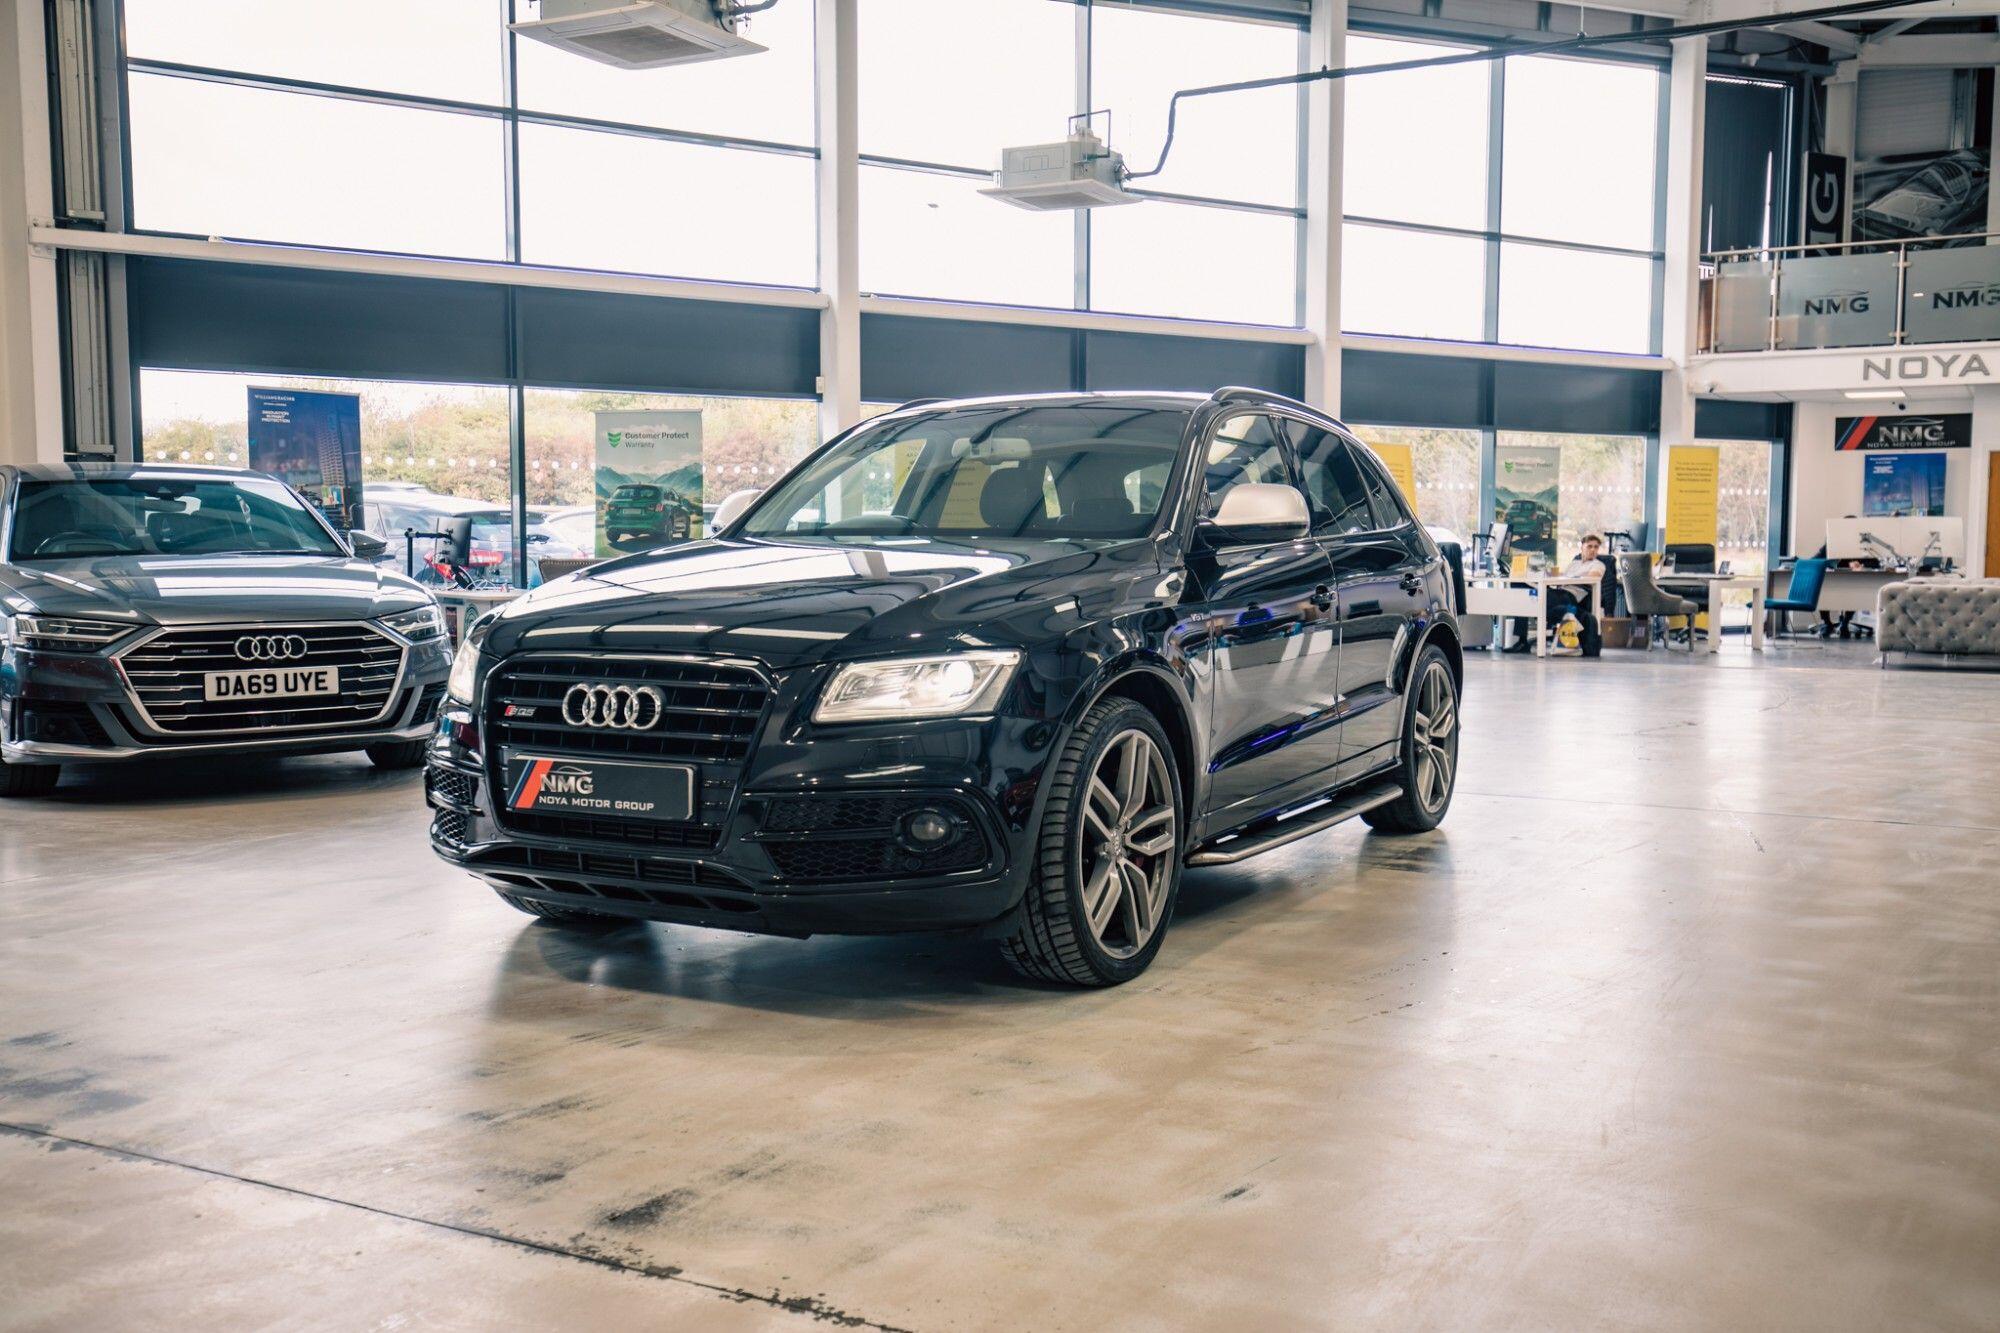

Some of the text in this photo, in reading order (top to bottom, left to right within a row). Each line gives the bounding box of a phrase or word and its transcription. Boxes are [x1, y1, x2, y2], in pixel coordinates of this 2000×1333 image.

[1804, 296, 1870, 315] NMG
[1932, 289, 2000, 309] NMG
[1863, 353, 1990, 381] NOYA
[1879, 425, 1944, 442] NMG
[216, 671, 328, 696] DA69 UYE
[540, 774, 593, 795] NMG
[539, 796, 654, 811] NOYA MOTOR GROUP
